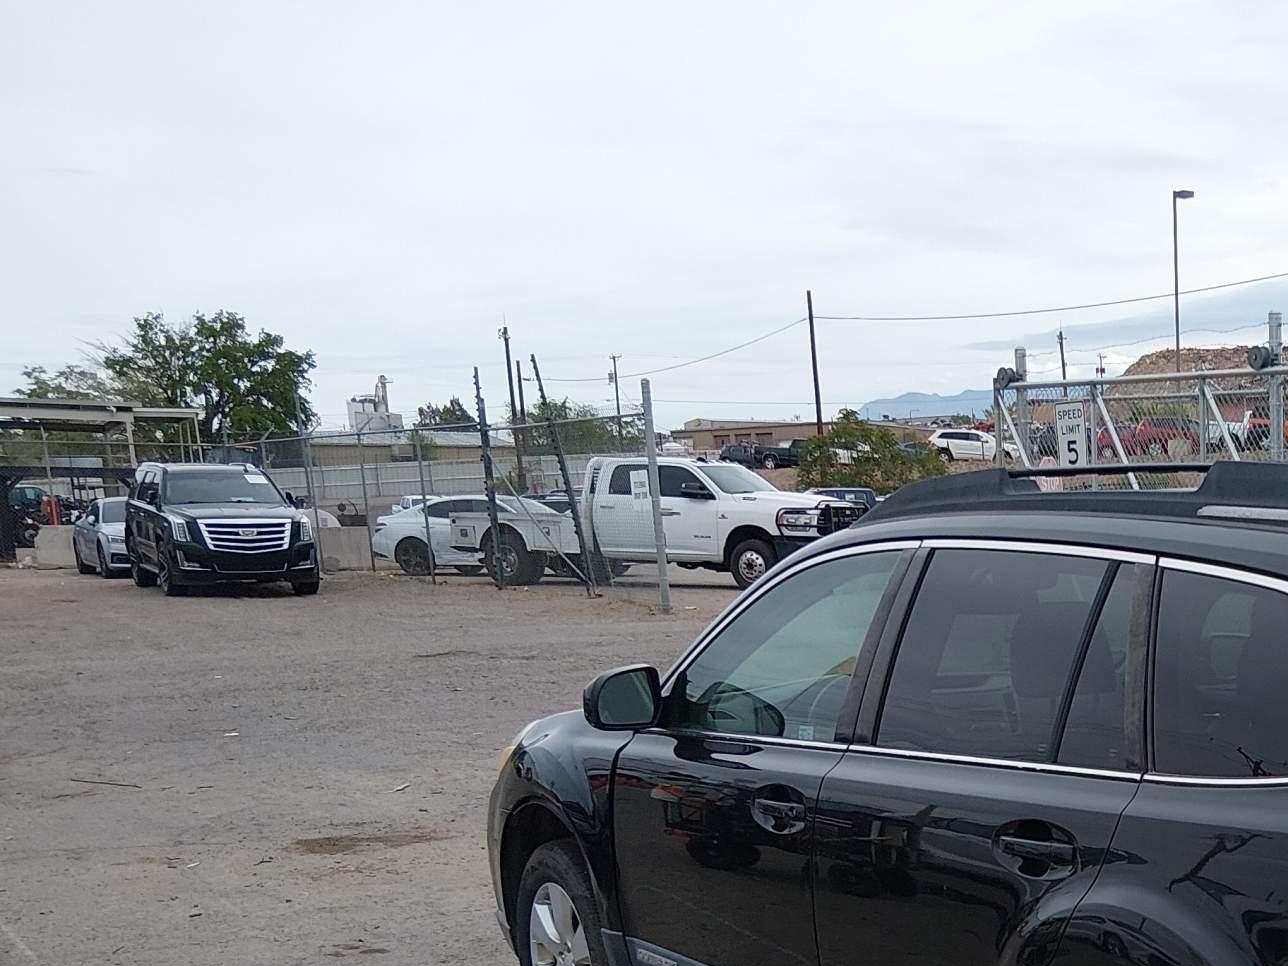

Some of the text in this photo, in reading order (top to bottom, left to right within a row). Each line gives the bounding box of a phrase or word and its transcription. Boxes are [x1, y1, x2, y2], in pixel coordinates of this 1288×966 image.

[1057, 409, 1082, 420] SPEED
[1061, 424, 1081, 436] LIMIT
[1067, 440, 1079, 465] 5
[1041, 478, 1059, 491] STOP
